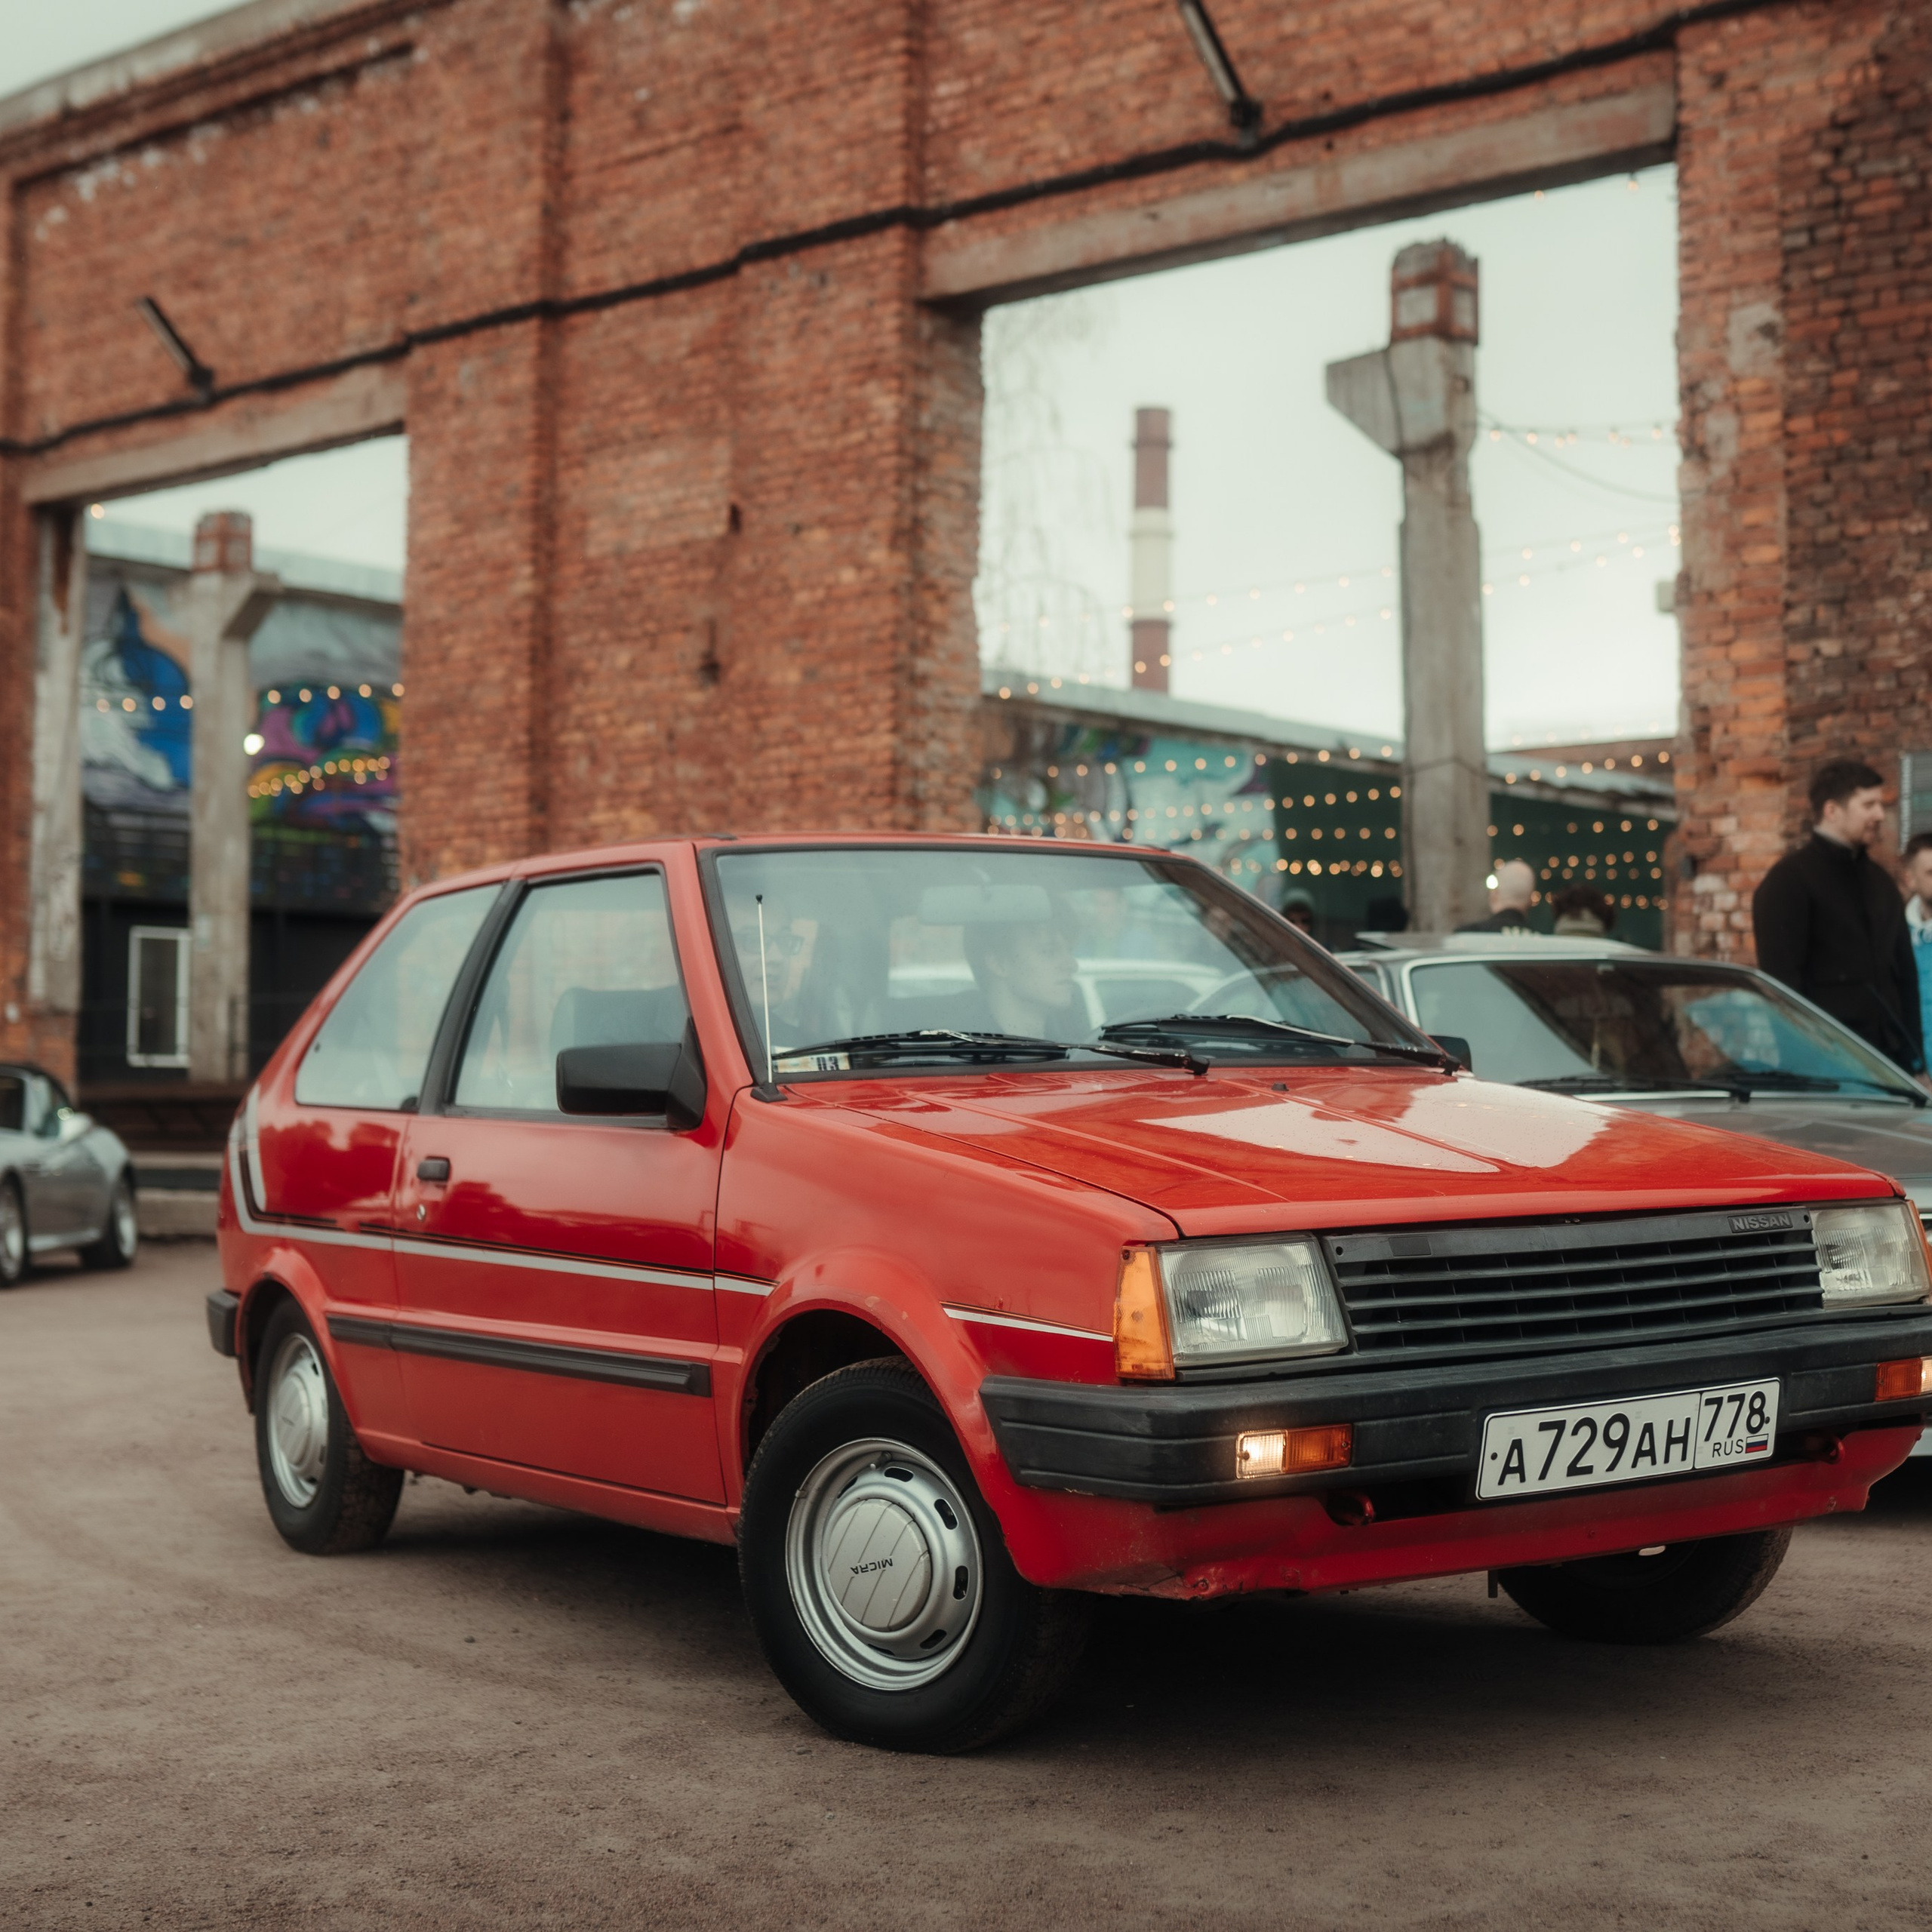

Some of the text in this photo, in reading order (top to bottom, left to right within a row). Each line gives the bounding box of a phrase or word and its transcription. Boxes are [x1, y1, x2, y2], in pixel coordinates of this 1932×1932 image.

[1732, 1214, 1791, 1231] NISSAN
[1497, 1390, 1767, 1486] A729AH 778
[1712, 1438, 1744, 1458] RUS
[850, 1558, 894, 1575] MICRA
